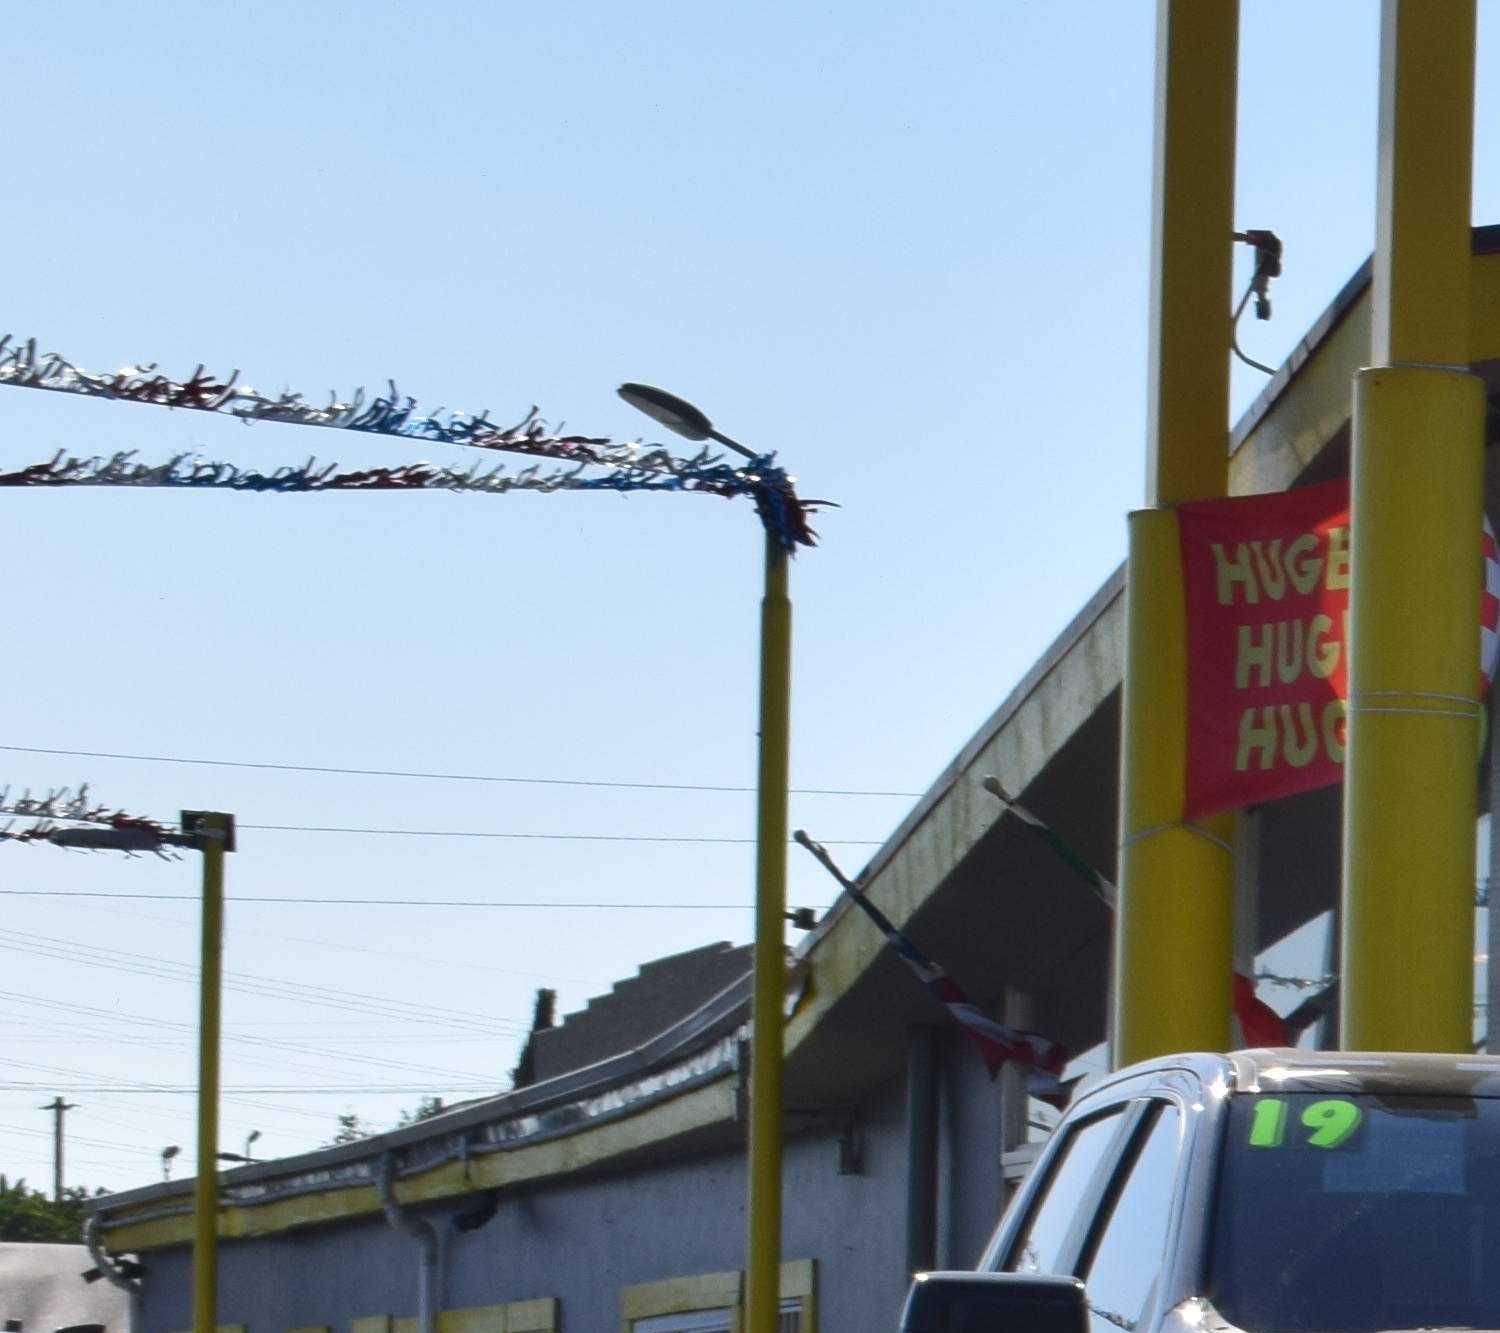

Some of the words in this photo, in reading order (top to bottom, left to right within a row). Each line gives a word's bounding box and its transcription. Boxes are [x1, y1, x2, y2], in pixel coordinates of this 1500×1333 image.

[1211, 527, 1349, 605] HUGE
[1235, 609, 1349, 689] HUG
[1234, 698, 1347, 771] HUG
[1249, 1099, 1362, 1148] 19
